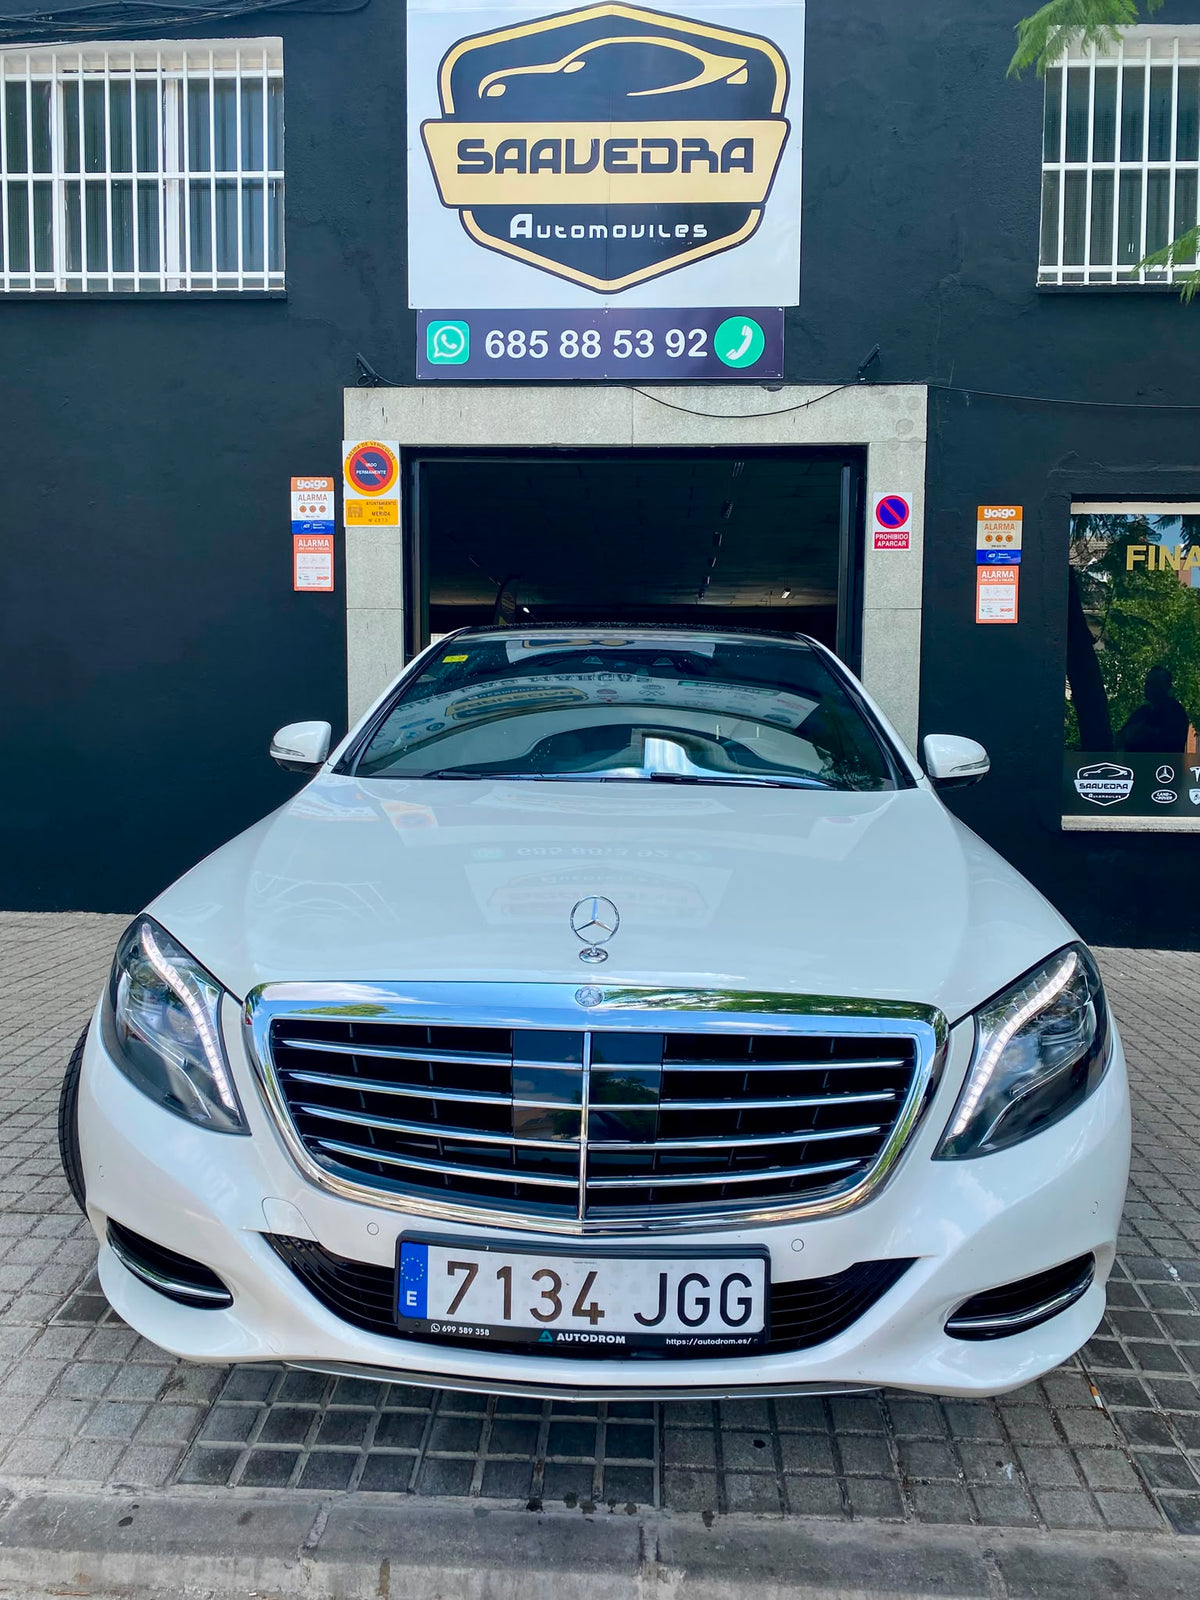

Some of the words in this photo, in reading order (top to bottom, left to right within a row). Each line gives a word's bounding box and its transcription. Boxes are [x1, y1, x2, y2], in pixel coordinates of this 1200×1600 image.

[457, 137, 754, 174] SAAVEDRA
[484, 330, 549, 358] 685
[559, 330, 602, 358] 88
[612, 330, 655, 358] 53
[665, 329, 708, 357] 92
[298, 494, 328, 502] ALARMA
[984, 523, 1015, 531] ALARMA
[298, 539, 329, 547] ALARMA
[981, 570, 1014, 579] ALARMA
[406, 1290, 418, 1307] E
[447, 1261, 605, 1325] 7134
[633, 1272, 752, 1327] JGG
[442, 1325, 457, 1334] 699
[459, 1327, 473, 1335] 589
[556, 1333, 626, 1344] AUTODROM
[666, 1338, 752, 1346] https://autodrom.es/
